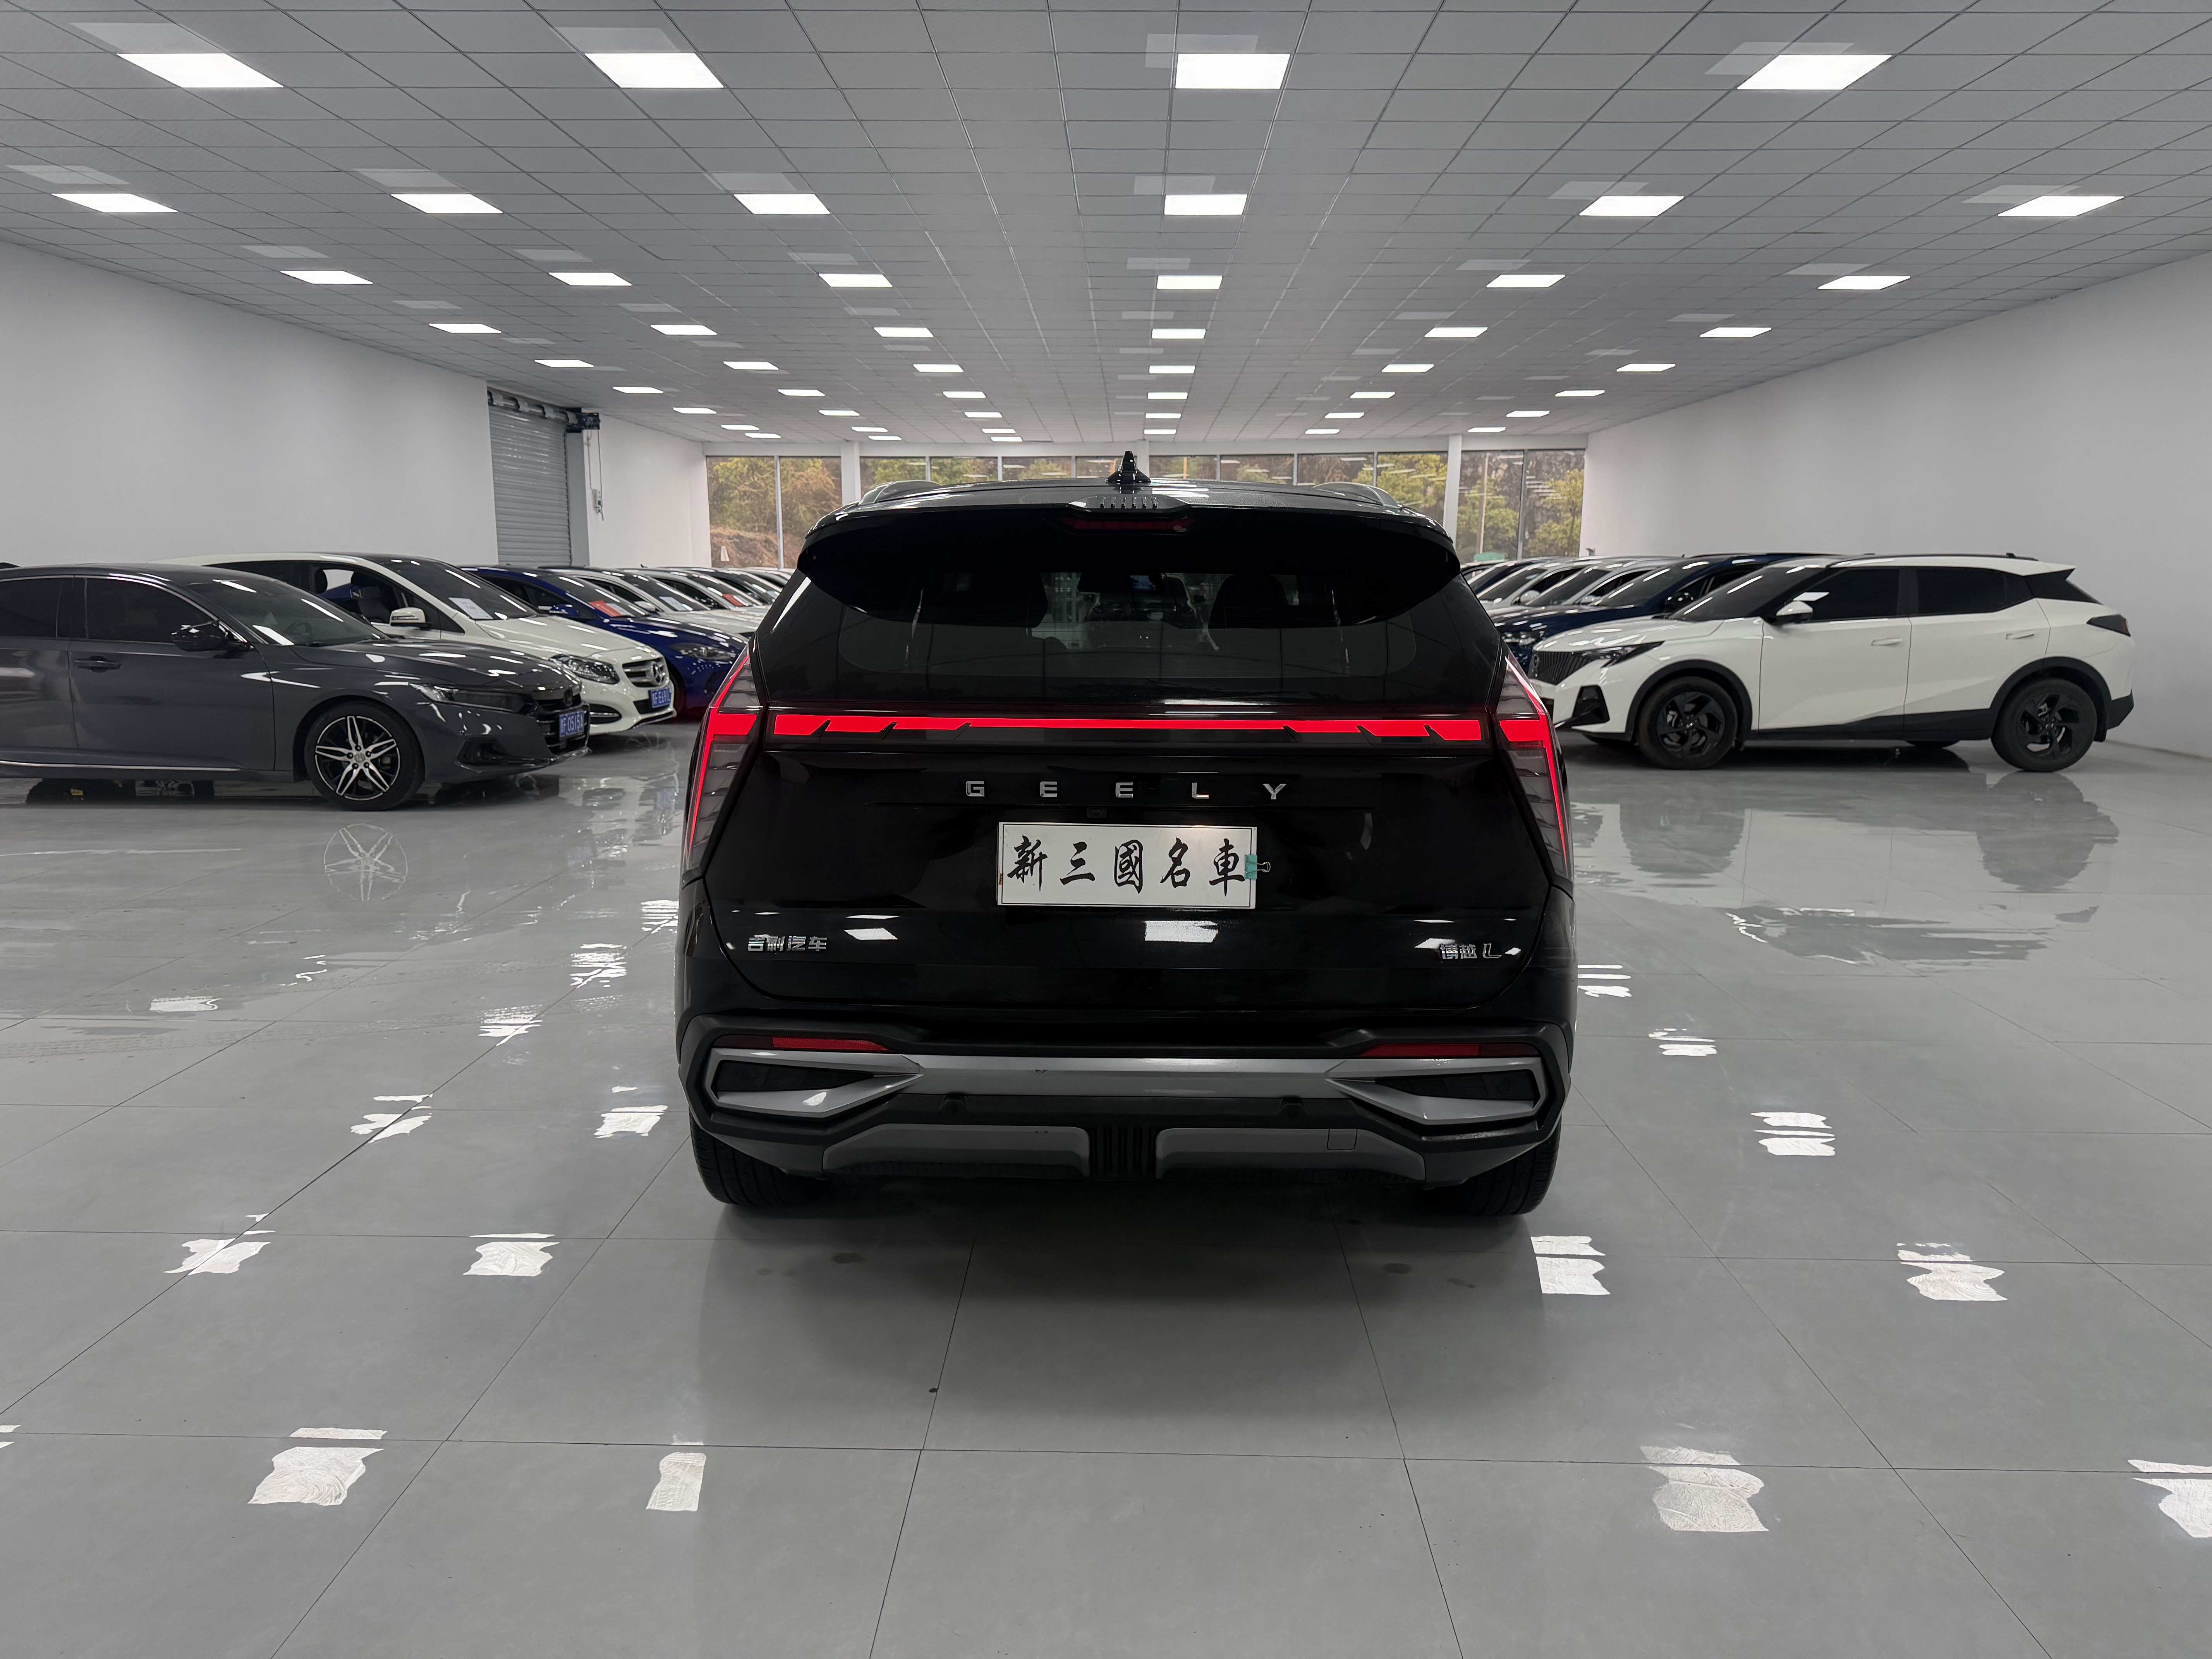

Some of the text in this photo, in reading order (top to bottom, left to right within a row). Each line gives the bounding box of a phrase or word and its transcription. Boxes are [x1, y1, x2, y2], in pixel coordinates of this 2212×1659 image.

[965, 780, 1286, 800] GEELY
[1007, 834, 1245, 896] 新三國名車
[747, 934, 827, 951] 吉利汽车
